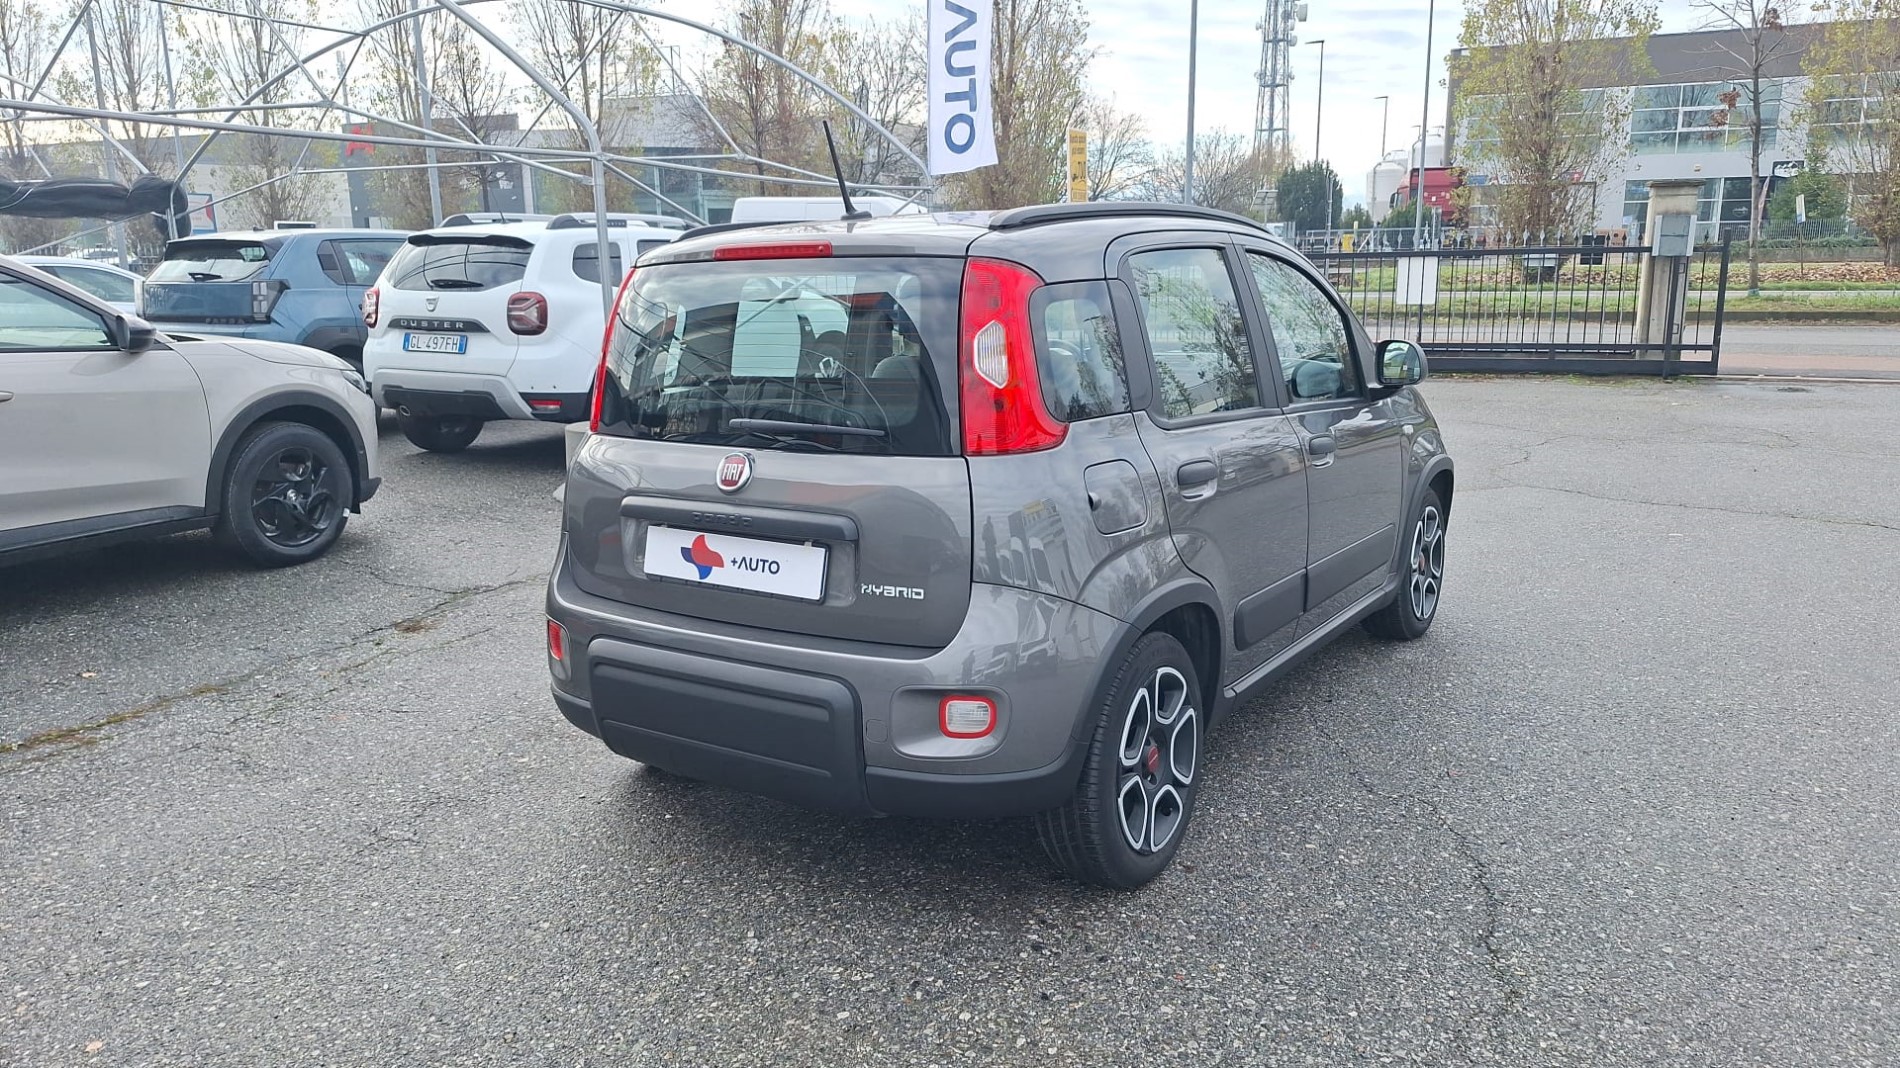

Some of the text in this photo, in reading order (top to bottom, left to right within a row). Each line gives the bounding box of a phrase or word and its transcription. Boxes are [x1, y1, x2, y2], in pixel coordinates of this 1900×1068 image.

[400, 319, 464, 329] DUSTER
[721, 463, 744, 481] FIAT
[861, 583, 924, 600] HYBRID
